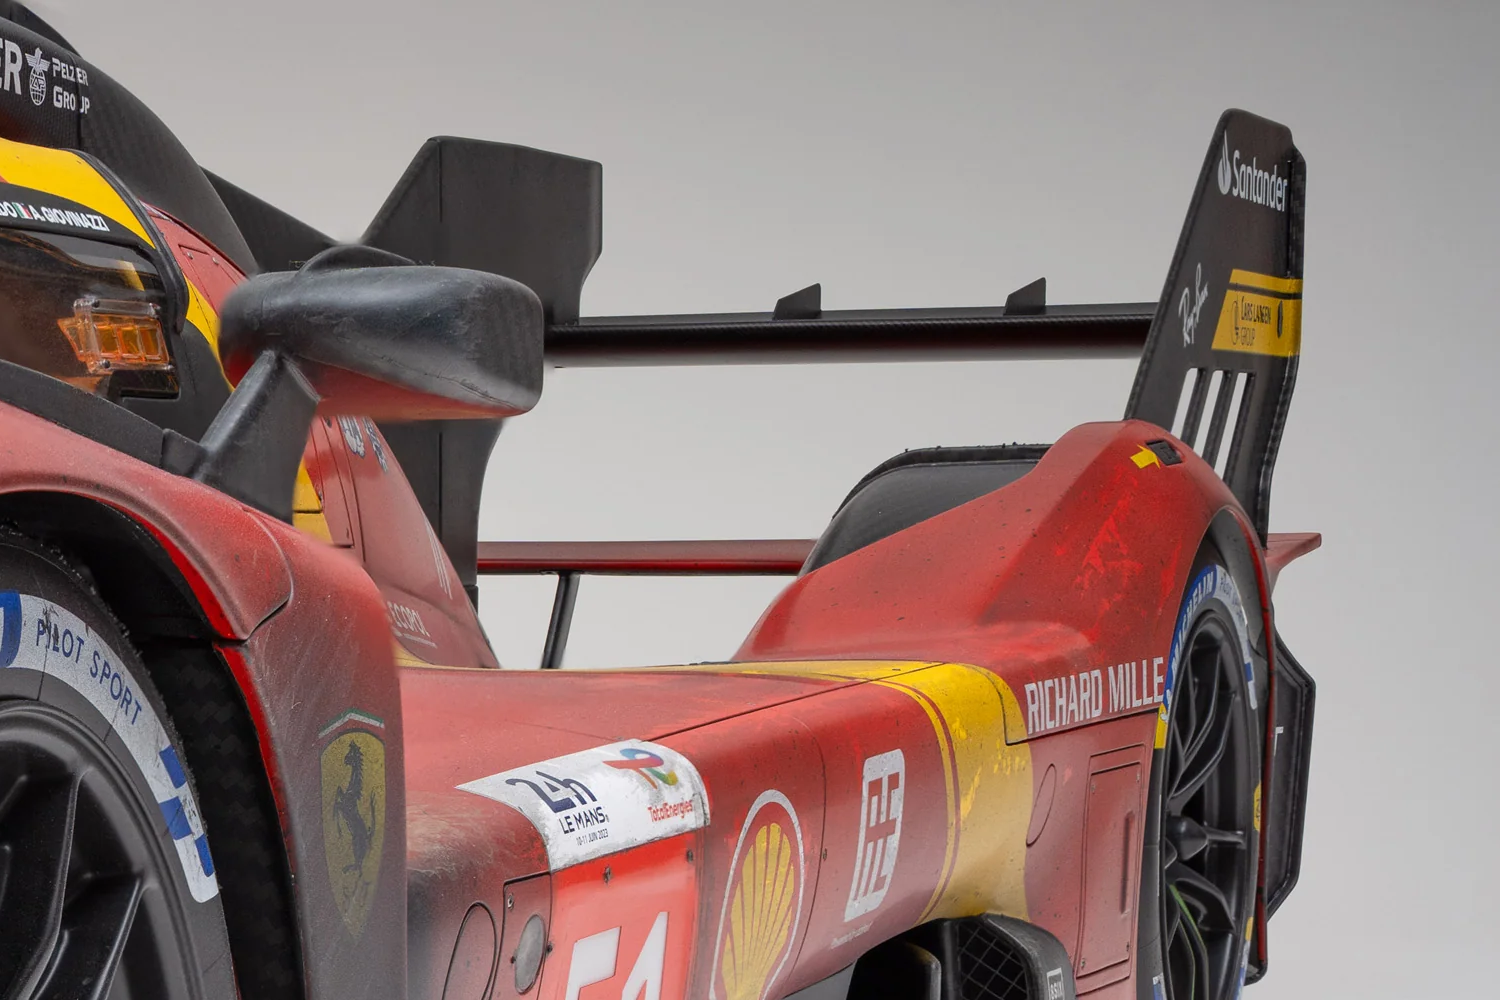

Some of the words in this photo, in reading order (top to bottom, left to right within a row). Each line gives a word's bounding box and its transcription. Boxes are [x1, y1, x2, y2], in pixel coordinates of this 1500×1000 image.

[52, 57, 89, 86] PELZER
[1232, 150, 1288, 212] Santander
[36, 618, 84, 664] PILOT
[90, 650, 143, 726] SPORT
[1024, 670, 1103, 735] RICHARD
[1108, 656, 1164, 714] MILLE
[559, 815, 576, 835] LE
[576, 807, 606, 831] MANS
[648, 799, 693, 823] TotalEnergies
[588, 833, 599, 844] JUIN
[598, 828, 609, 840] 2023
